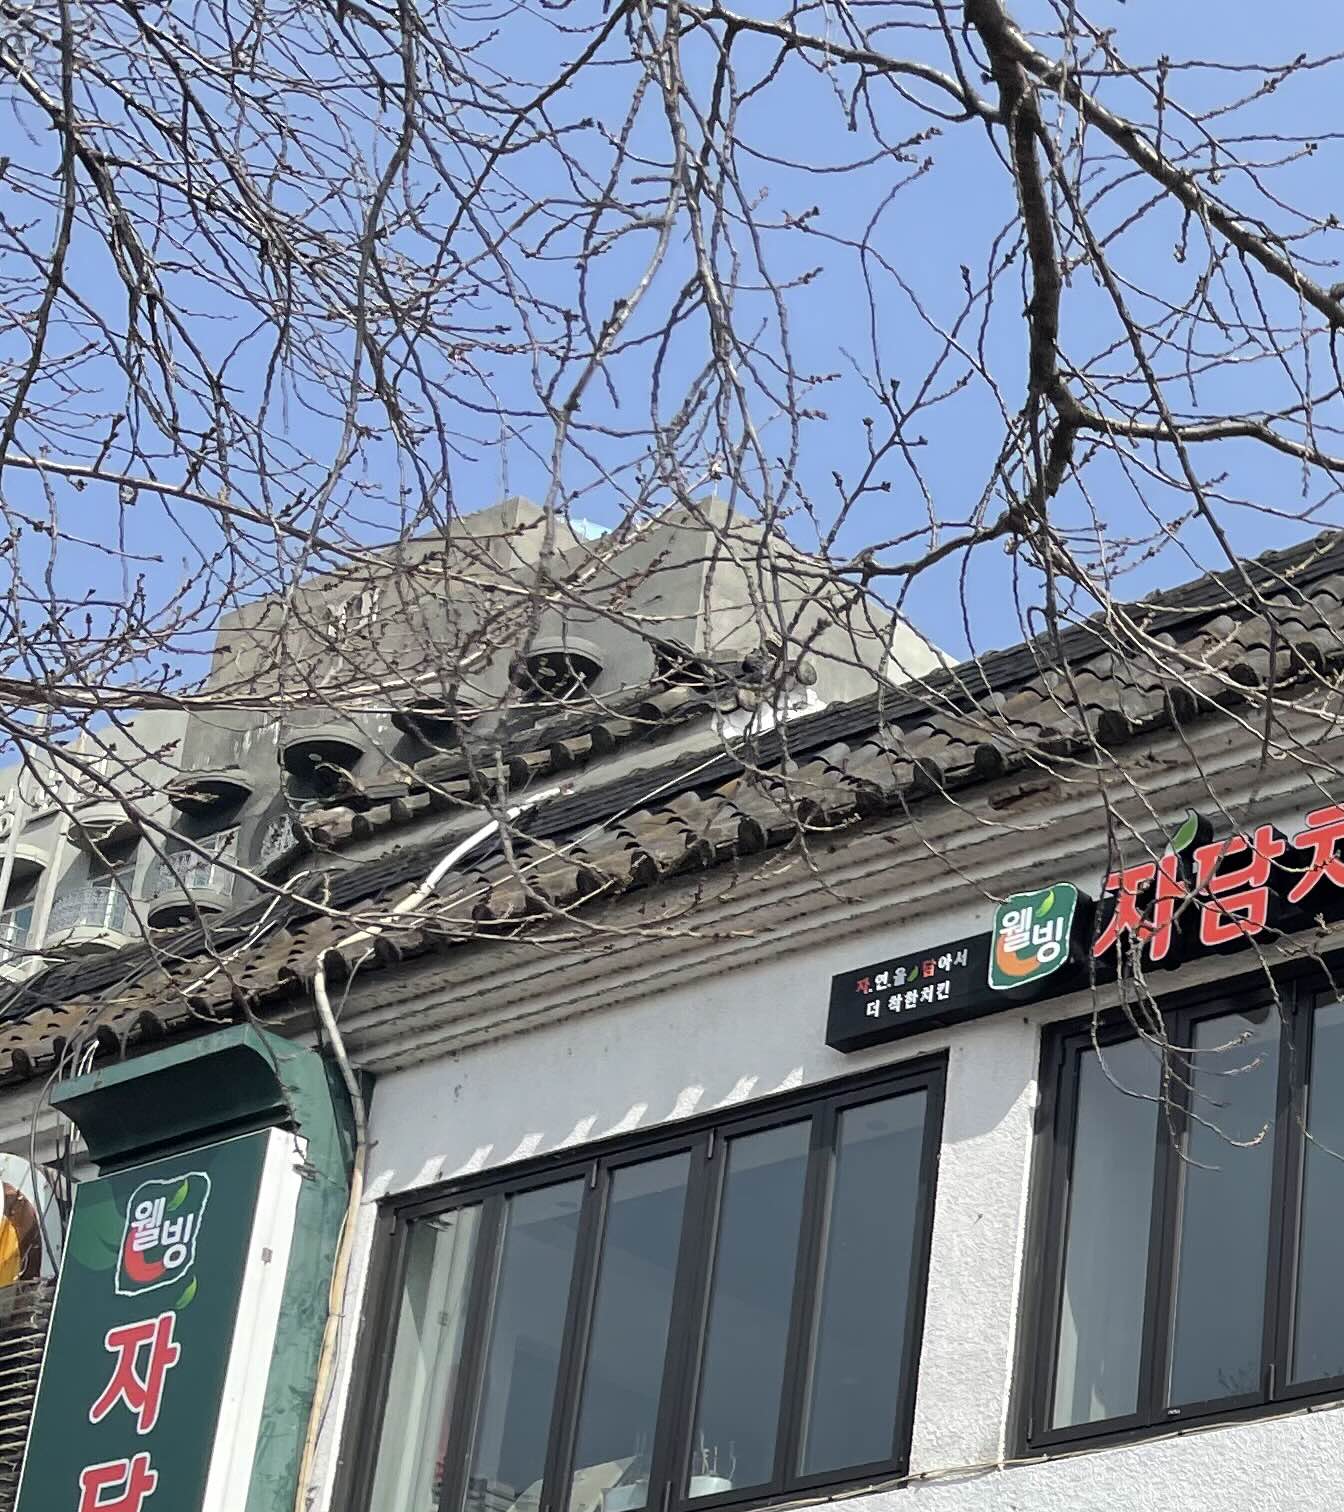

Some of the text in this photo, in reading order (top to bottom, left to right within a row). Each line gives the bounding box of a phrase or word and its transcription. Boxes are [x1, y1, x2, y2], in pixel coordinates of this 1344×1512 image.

[1000, 906, 1063, 963] 웰빙
[866, 980, 950, 1018] 더 착한치킨
[131, 1197, 194, 1269] 웰빙
